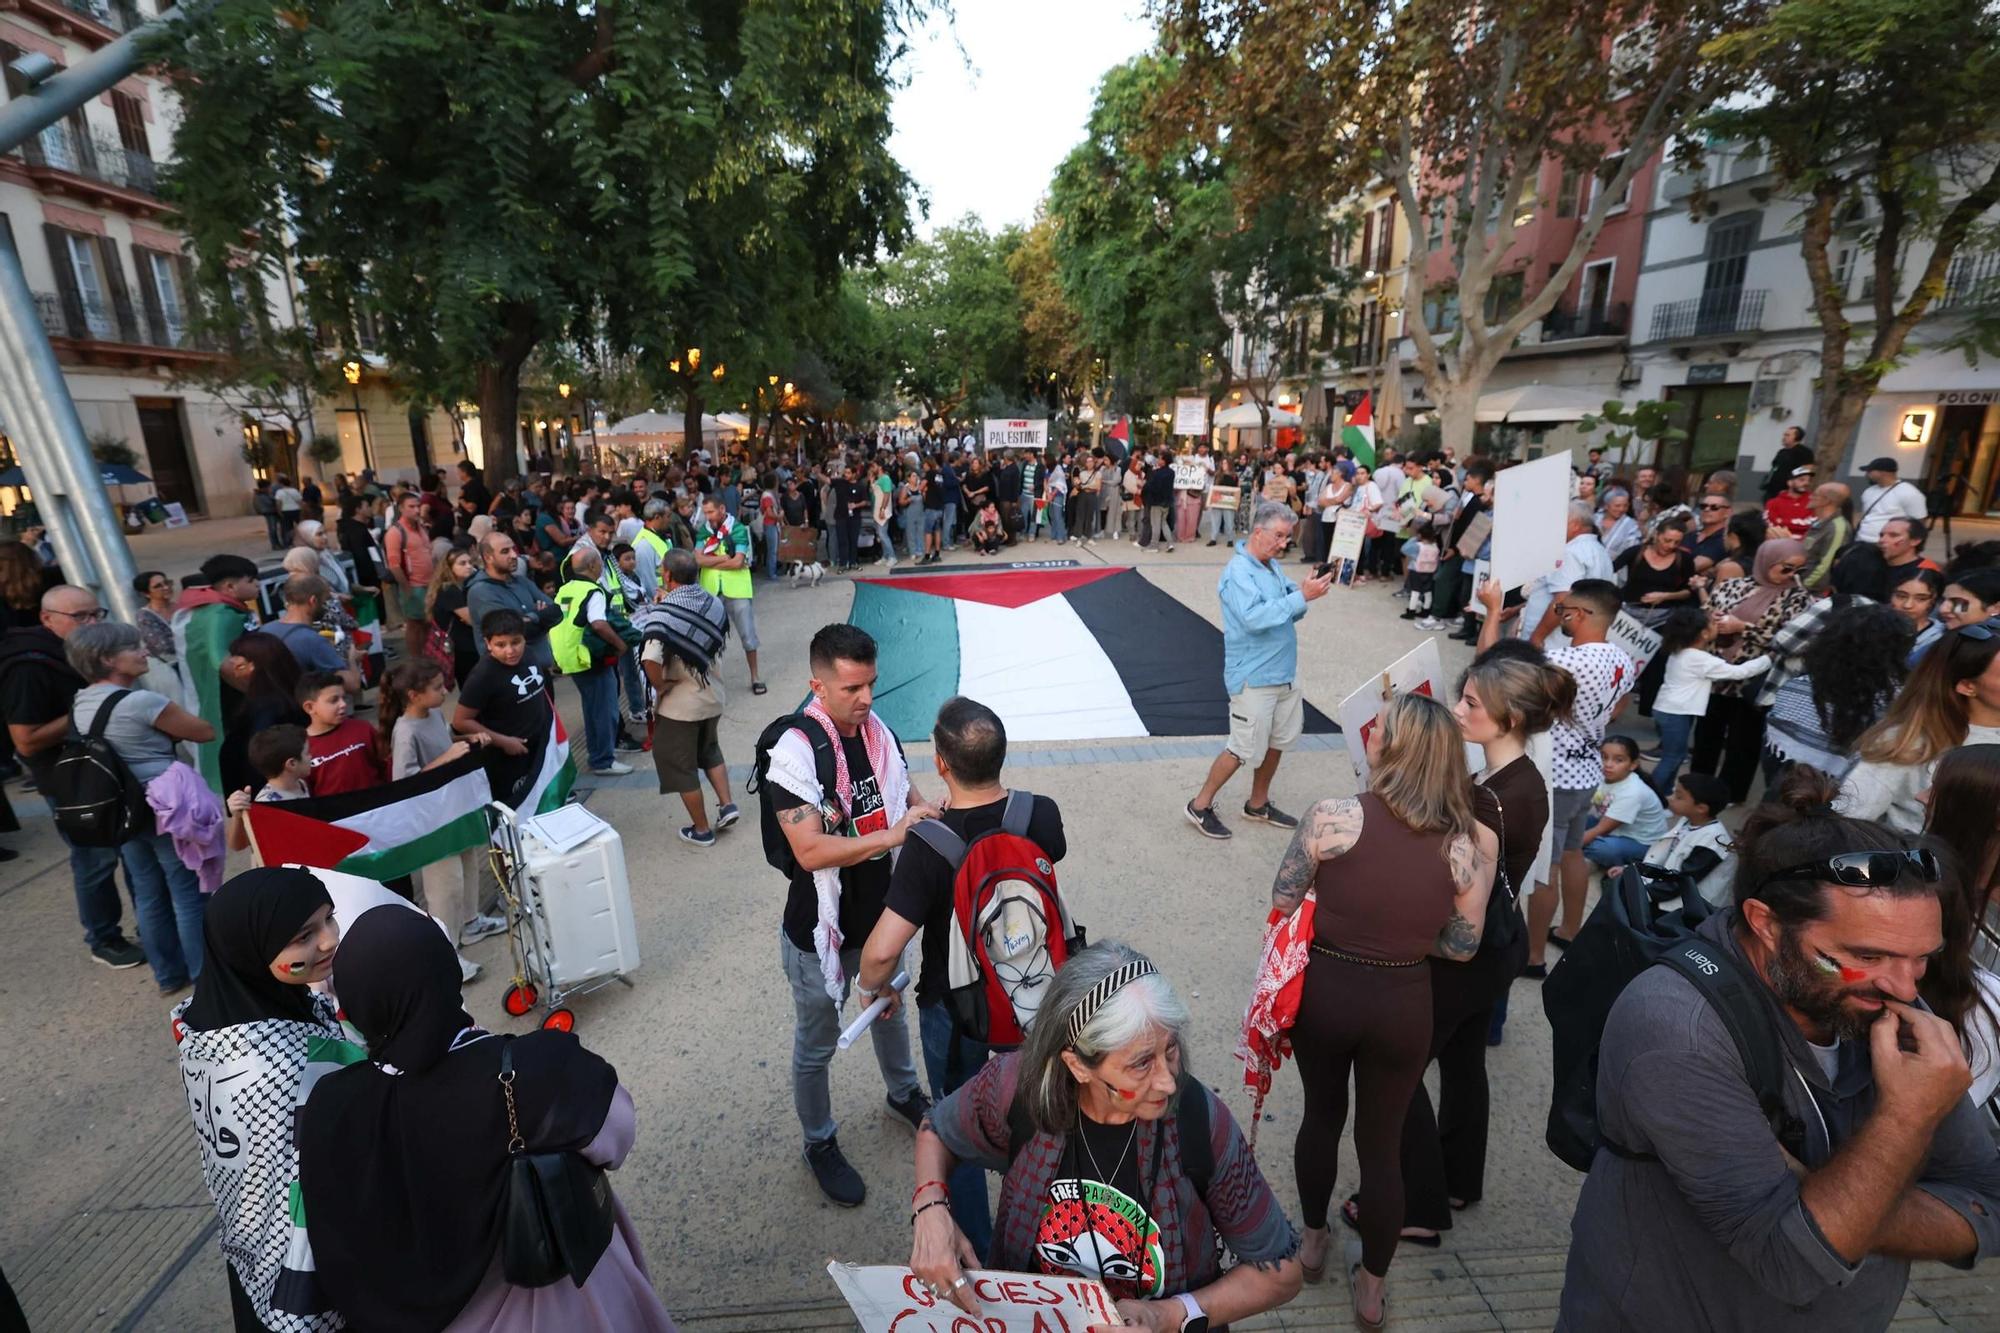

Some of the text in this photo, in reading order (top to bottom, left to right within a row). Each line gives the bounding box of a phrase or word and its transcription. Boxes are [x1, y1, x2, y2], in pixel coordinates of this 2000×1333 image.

[990, 431, 1040, 444] PALESTINE
[1685, 949, 1719, 975] Slam
[1050, 1183, 1080, 1203] FREE
